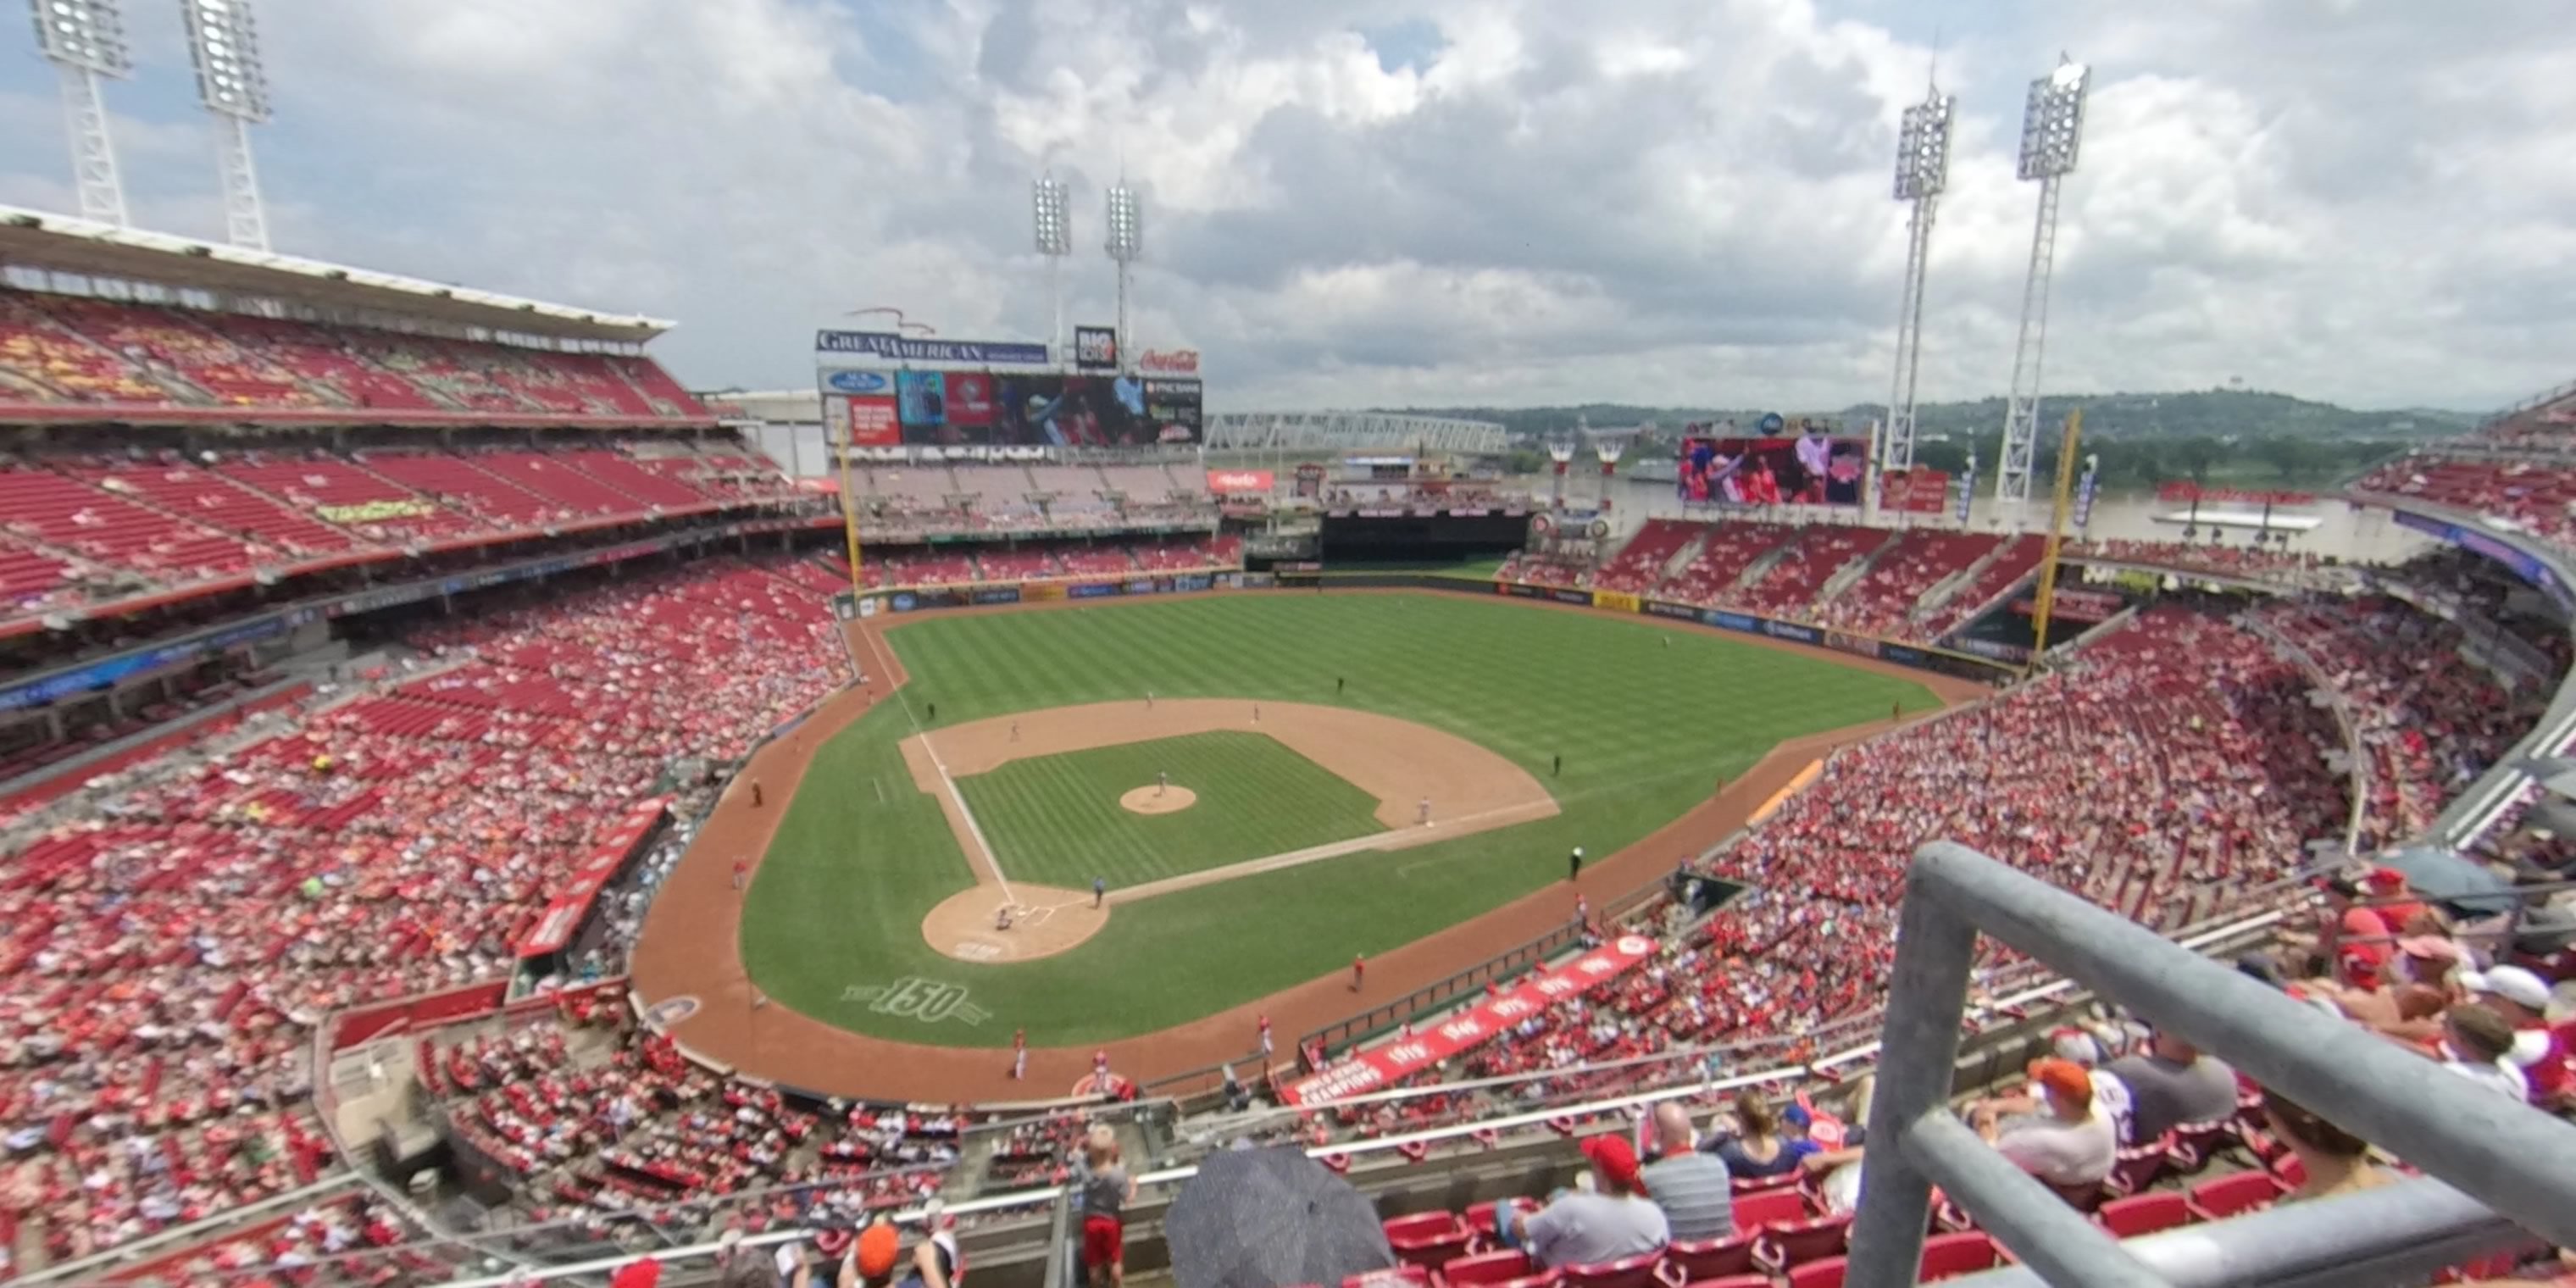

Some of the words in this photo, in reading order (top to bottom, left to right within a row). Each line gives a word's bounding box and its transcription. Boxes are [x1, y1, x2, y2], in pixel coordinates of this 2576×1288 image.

[888, 338, 983, 360] AMERICAN
[1079, 331, 1112, 347] BIG
[869, 976, 968, 1022] 150
[1388, 1041, 1427, 1065] 1919
[1300, 1065, 1382, 1106] CHAMPIONS
